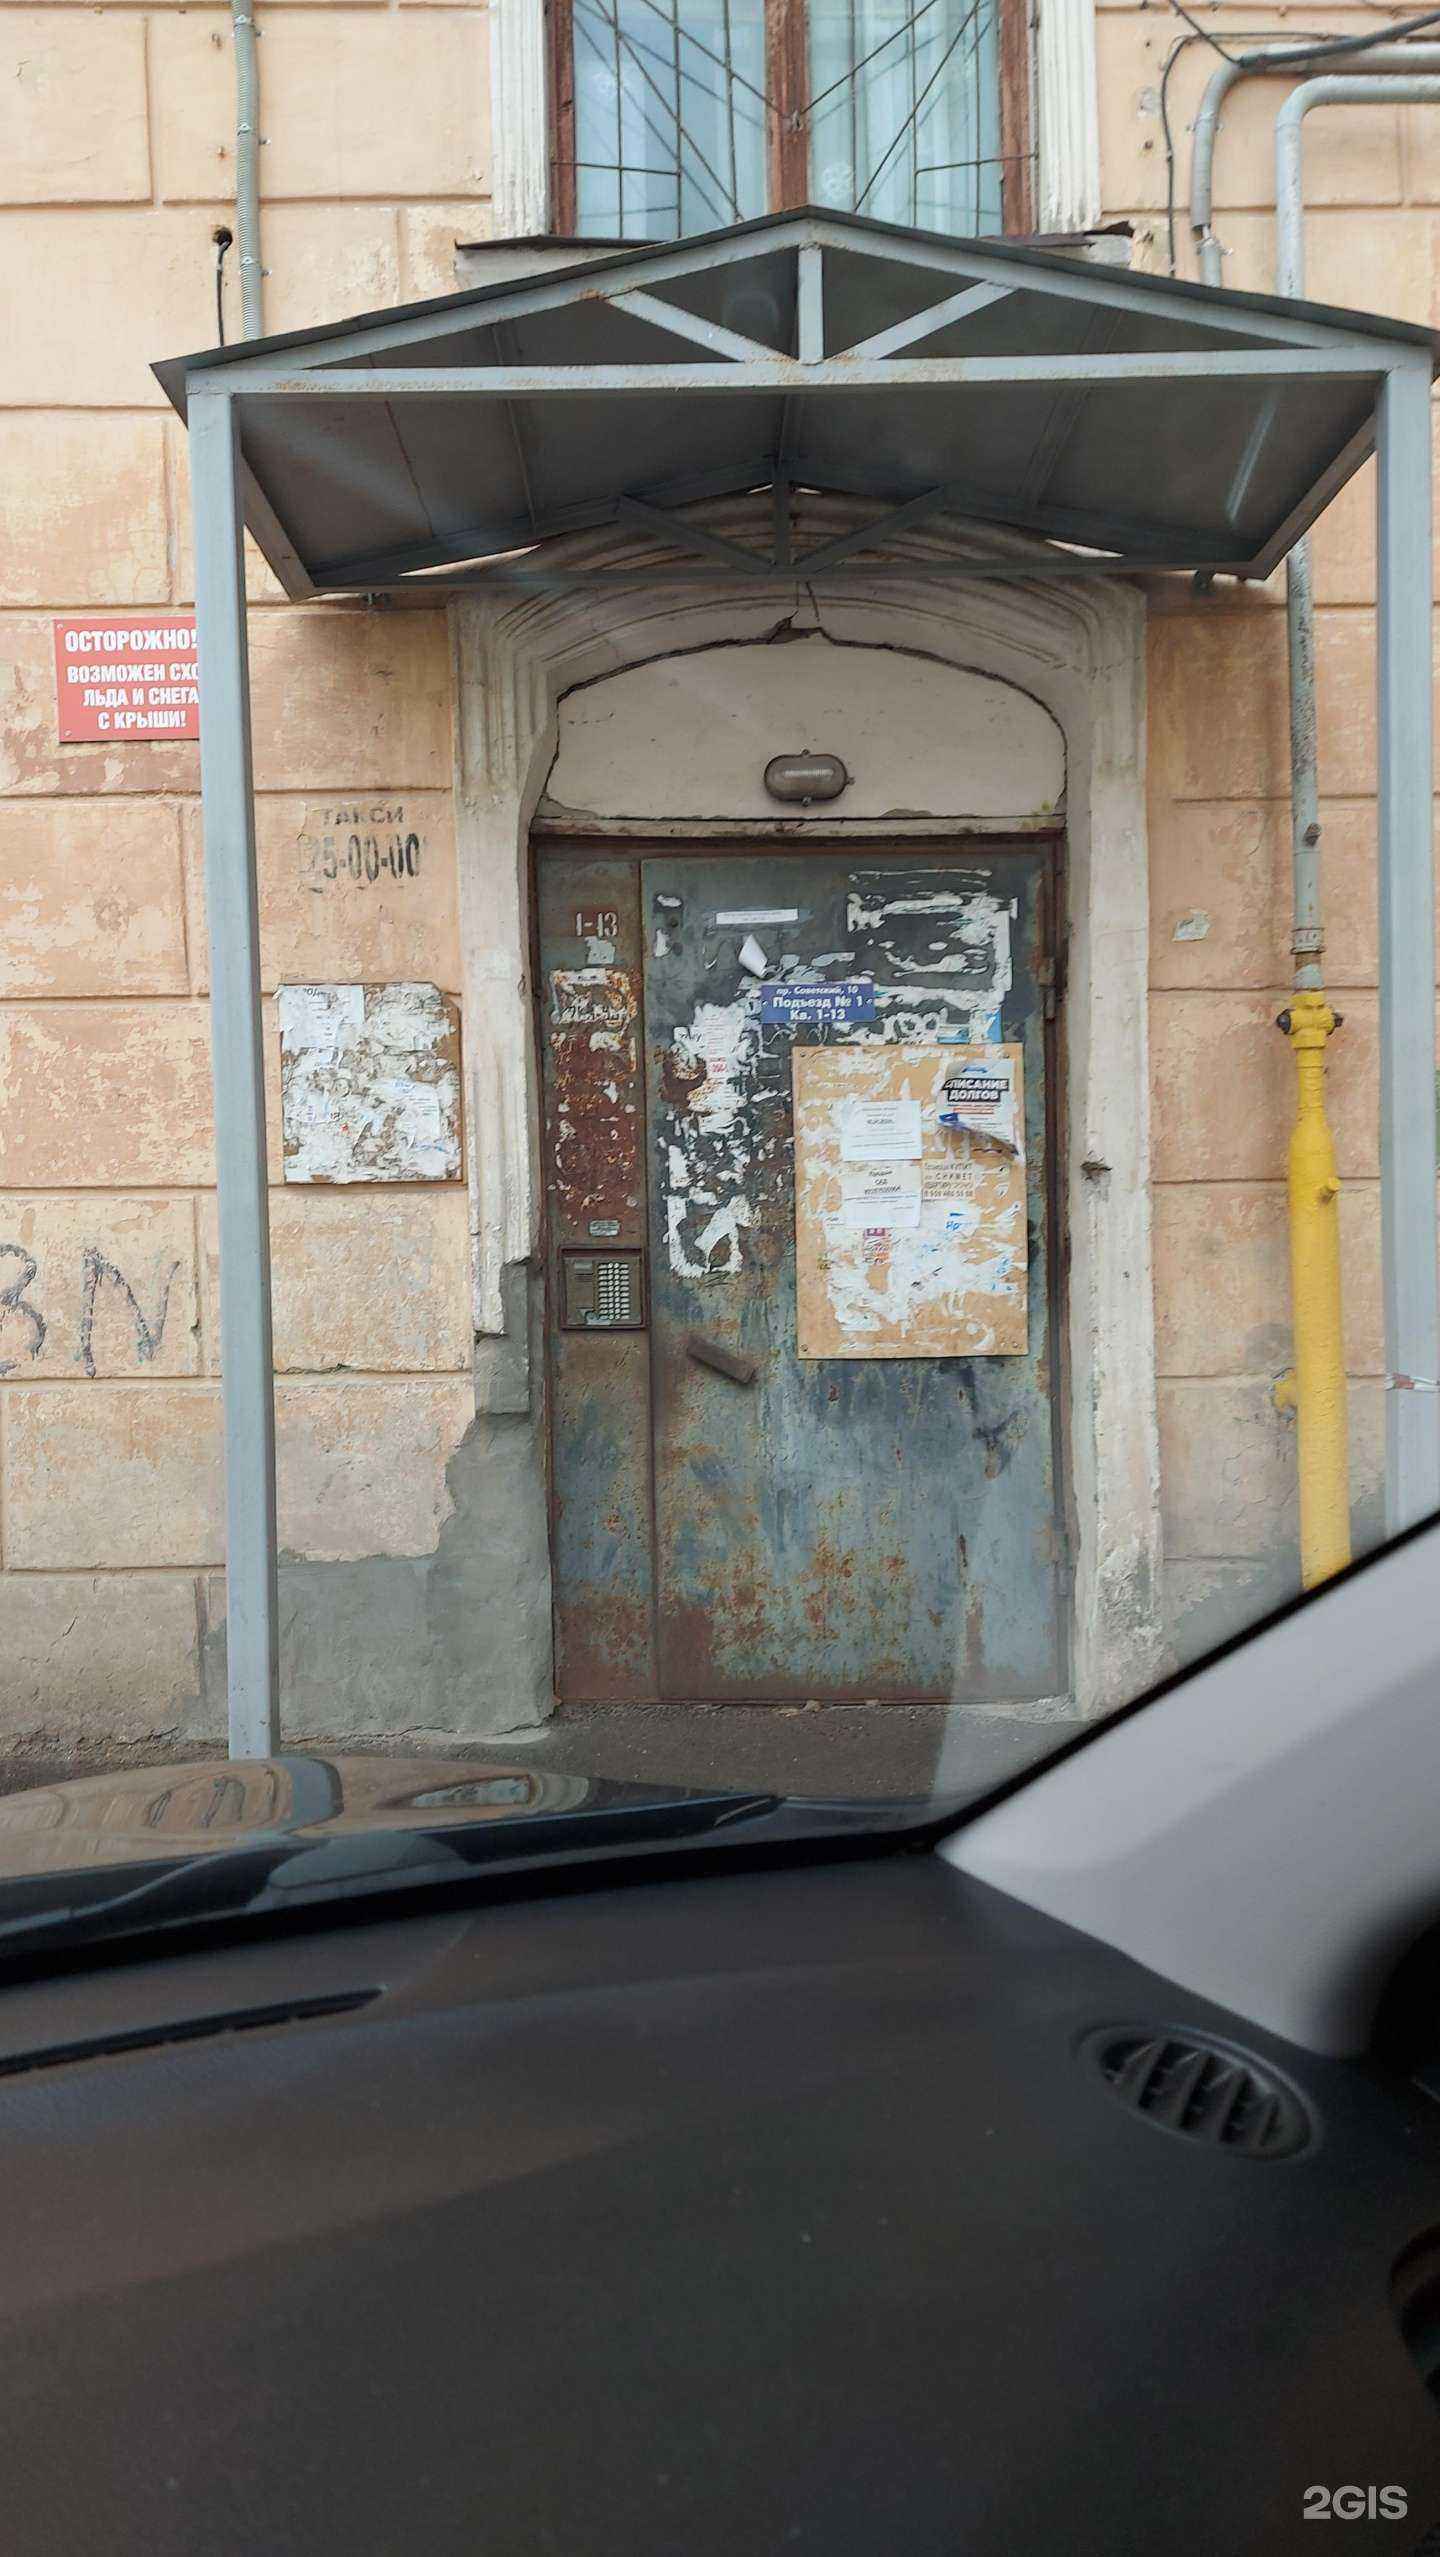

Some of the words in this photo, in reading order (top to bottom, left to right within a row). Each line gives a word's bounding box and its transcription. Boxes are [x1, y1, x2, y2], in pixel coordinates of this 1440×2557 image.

[64, 629, 197, 652] ОСТОРОЖНО!
[67, 665, 166, 683] ВОЗМОЖЕН
[169, 662, 199, 681] СХО
[83, 688, 128, 707] ЛЬДА
[132, 688, 145, 705] И
[149, 687, 199, 705] СНЕГА
[98, 712, 110, 729] С
[114, 710, 187, 729] КРЫШИ!
[576, 912, 618, 937] 1-13
[847, 985, 859, 994] 10
[772, 997, 832, 1009] Подъезд
[856, 996, 863, 1007] 1
[789, 1010, 812, 1020] Кв.
[816, 1009, 846, 1020] 1-13
[949, 1090, 999, 1100] ДОЛГОВ
